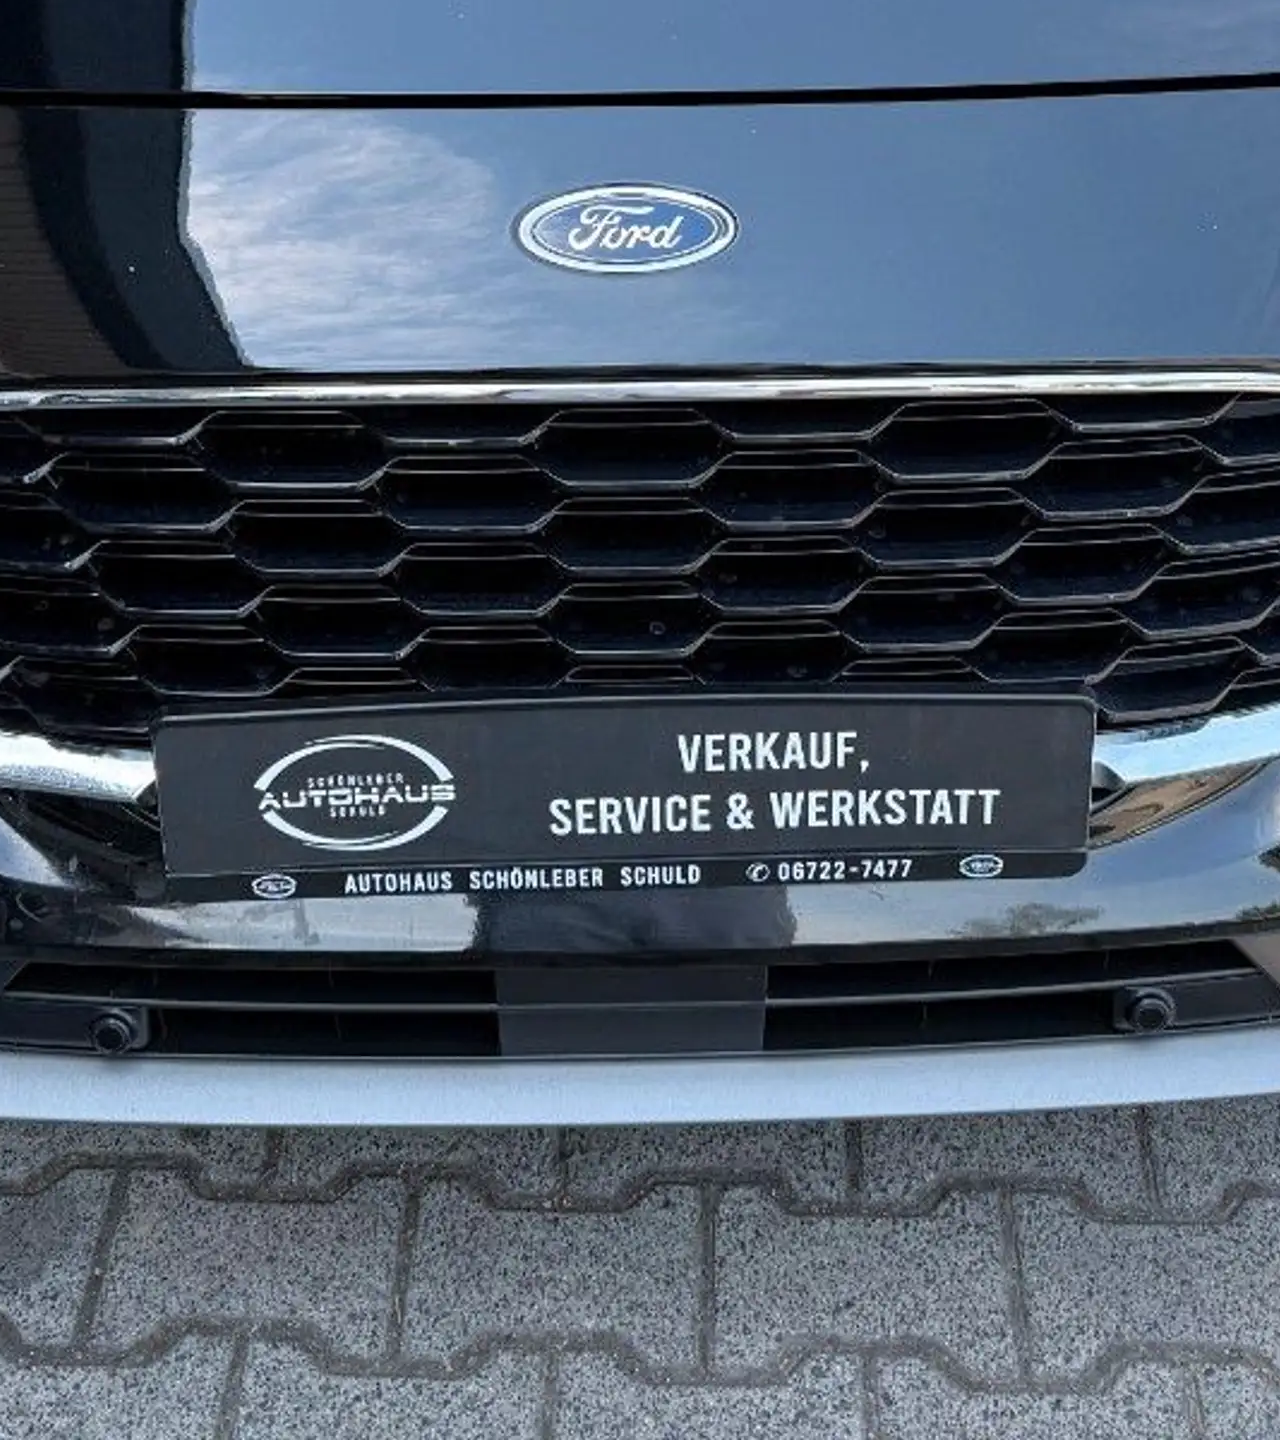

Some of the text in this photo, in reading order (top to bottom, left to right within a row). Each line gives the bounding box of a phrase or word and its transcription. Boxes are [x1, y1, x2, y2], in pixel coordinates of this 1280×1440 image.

[567, 203, 685, 251] Ford
[677, 730, 870, 774] VERKAUF,
[258, 784, 456, 811] AUTOHAUS
[548, 788, 1001, 836] SERVICE & WERKSTATT
[343, 864, 702, 895] AUTOHAUS SCHÖNLEBER SCHULD
[777, 859, 913, 881] 06722-7477
